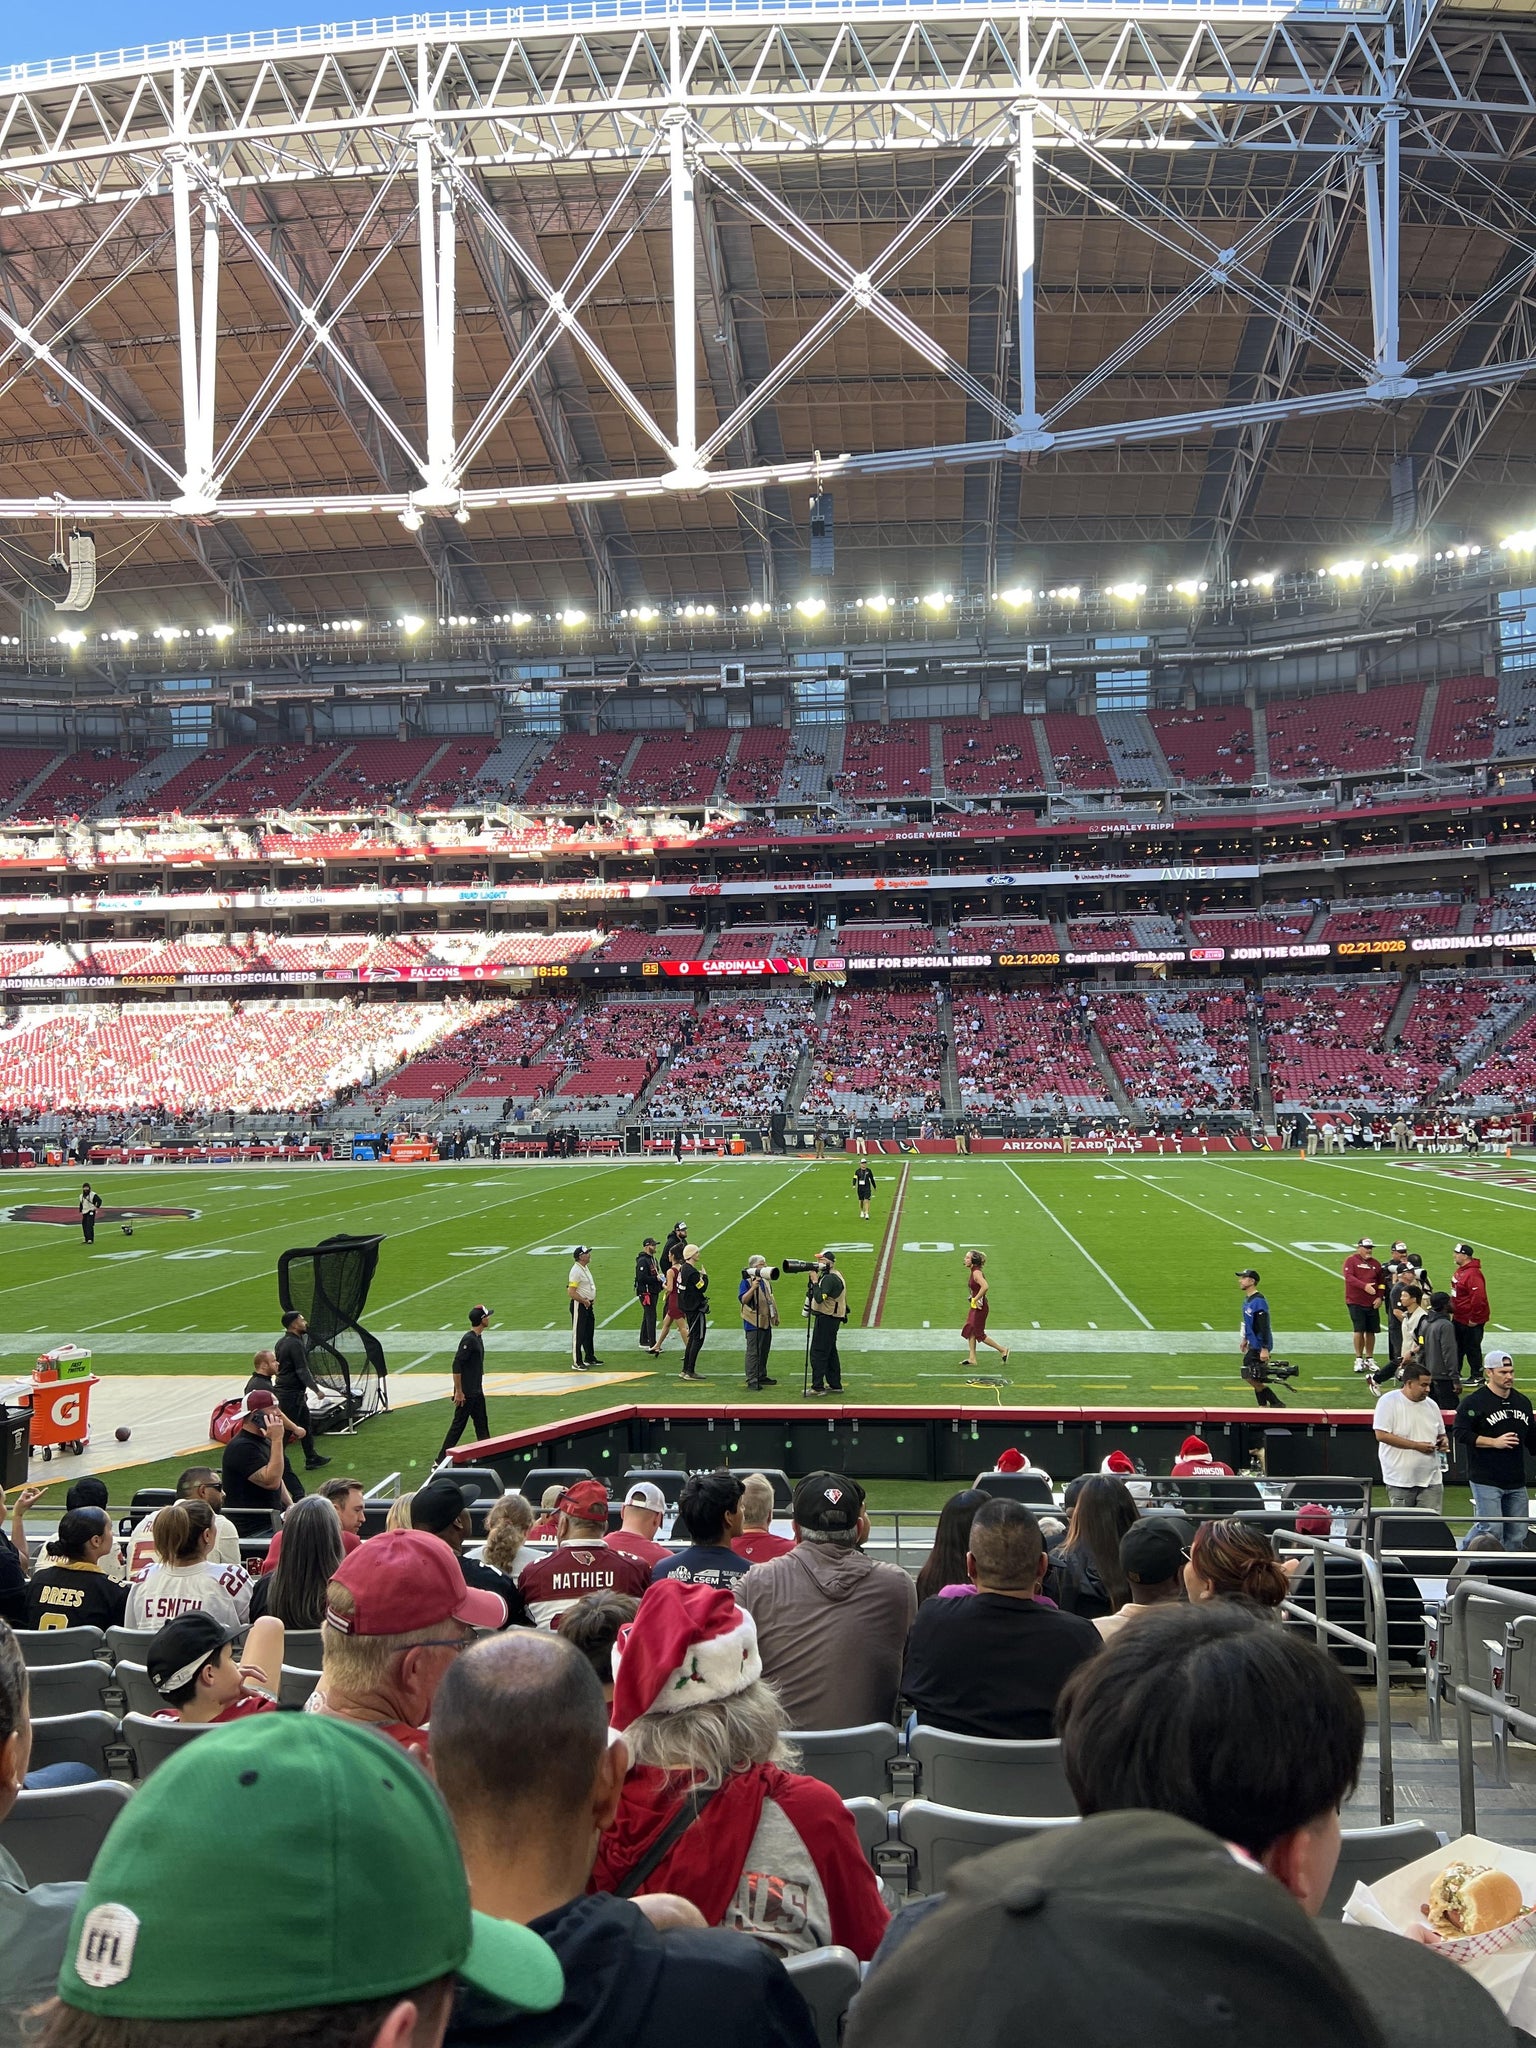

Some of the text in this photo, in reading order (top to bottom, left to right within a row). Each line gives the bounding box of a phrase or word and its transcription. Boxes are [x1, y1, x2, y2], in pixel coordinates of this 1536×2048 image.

[1088, 822, 1175, 833] 62 CHARLEY TRIPPI
[884, 831, 961, 841] 22 ROGER WEHRLI
[1160, 867, 1219, 880] AVNET
[1338, 940, 1407, 954] 02.21.2026
[1411, 935, 1493, 951] CARDINALS
[998, 950, 1185, 966] 02.21.2026 CardinalsClimb.com
[1230, 944, 1331, 960] JOIN THE CLIMB
[679, 959, 765, 974] 0 CARDINALS
[849, 955, 992, 969] HIKE FOR SPECIAL NEEDS
[410, 967, 484, 978] FALCONS 0
[518, 966, 526, 977] 1
[532, 966, 568, 977] 18:56
[121, 976, 176, 986] 02.21.2026
[183, 972, 317, 985] HIKE FOR SPECIAL NEEDS
[1002, 1140, 1063, 1150] ARIZONA
[67, 1366, 86, 1374] TWITCH
[51, 1392, 80, 1427] G
[1191, 1466, 1225, 1476] JOHNSON
[552, 1571, 614, 1590] MATHIEU
[692, 1575, 720, 1585] CSEM
[39, 1585, 85, 1607] BREES
[145, 1598, 154, 1618] E
